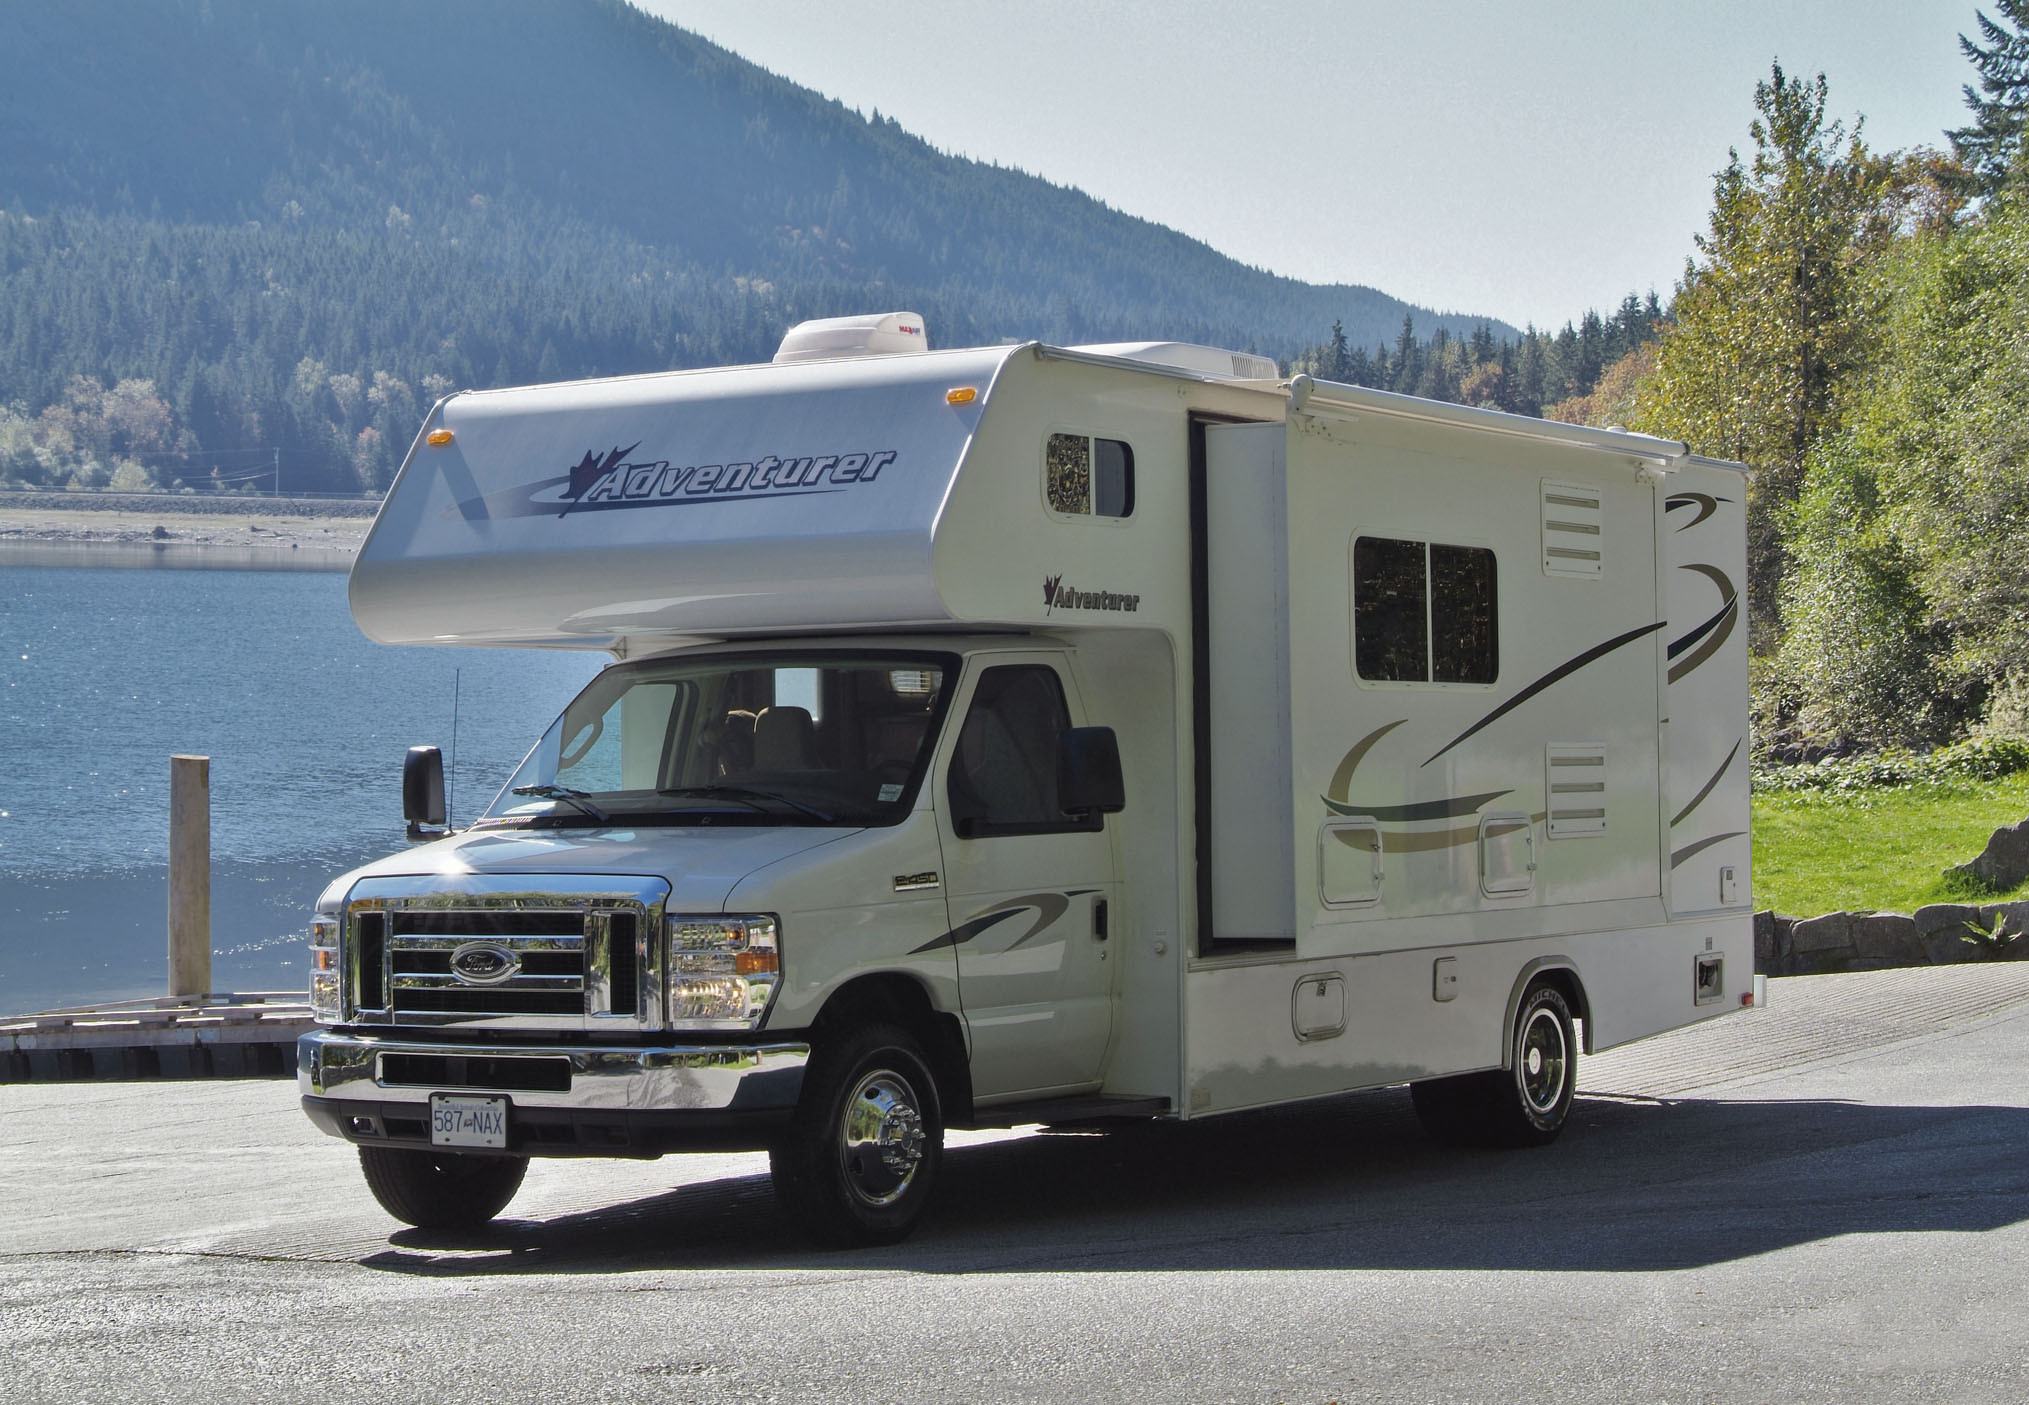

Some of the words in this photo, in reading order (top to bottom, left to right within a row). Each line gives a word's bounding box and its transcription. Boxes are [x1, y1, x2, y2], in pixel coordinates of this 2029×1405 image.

[587, 450, 898, 501] Adventurer
[1053, 585, 1140, 612] Adventurer
[465, 954, 494, 971] Ford
[434, 1110, 463, 1133] 587
[473, 1111, 502, 1135] NAX
